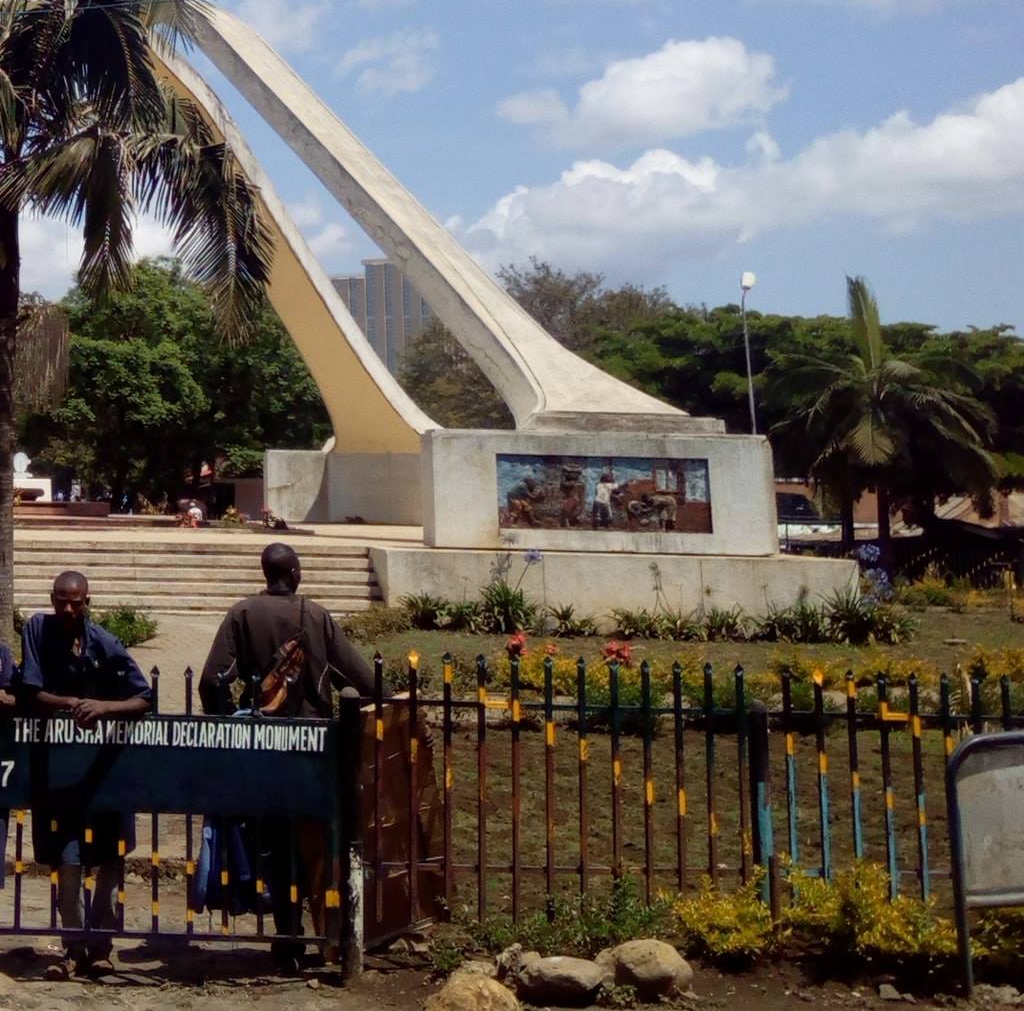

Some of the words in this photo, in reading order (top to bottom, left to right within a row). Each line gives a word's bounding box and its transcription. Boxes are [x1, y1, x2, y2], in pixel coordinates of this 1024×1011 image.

[12, 717, 41, 744] THE
[105, 720, 169, 746] MEMORIAL
[172, 721, 252, 750] DECLARATION
[253, 723, 327, 752] MONUMENT
